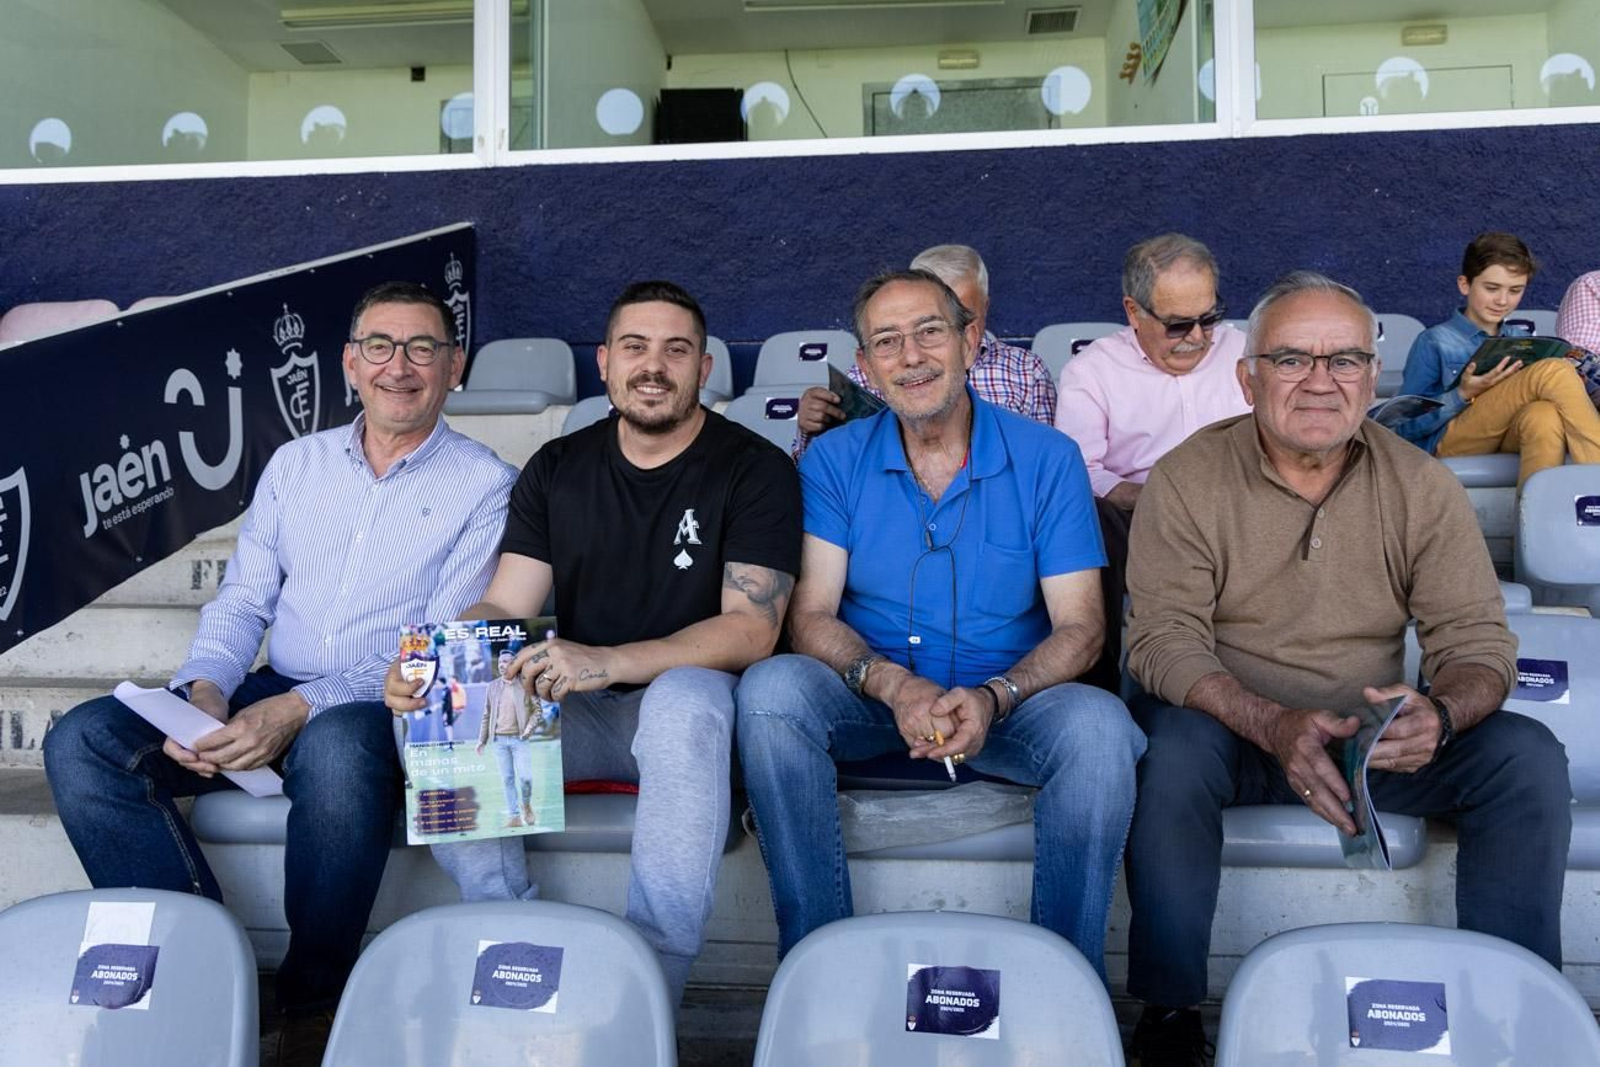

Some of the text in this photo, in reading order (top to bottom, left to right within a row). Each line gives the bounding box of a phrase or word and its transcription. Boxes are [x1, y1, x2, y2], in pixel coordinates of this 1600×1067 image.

[102, 486, 175, 530] te está esperando
[444, 625, 527, 641] ES REAL
[410, 748, 427, 758] En
[411, 763, 485, 777] de un mito
[91, 970, 138, 981] ABONADOS
[492, 970, 542, 982] ABONADOS
[925, 995, 980, 1007] ABONADOS
[1368, 1009, 1425, 1021] ABONADOS
